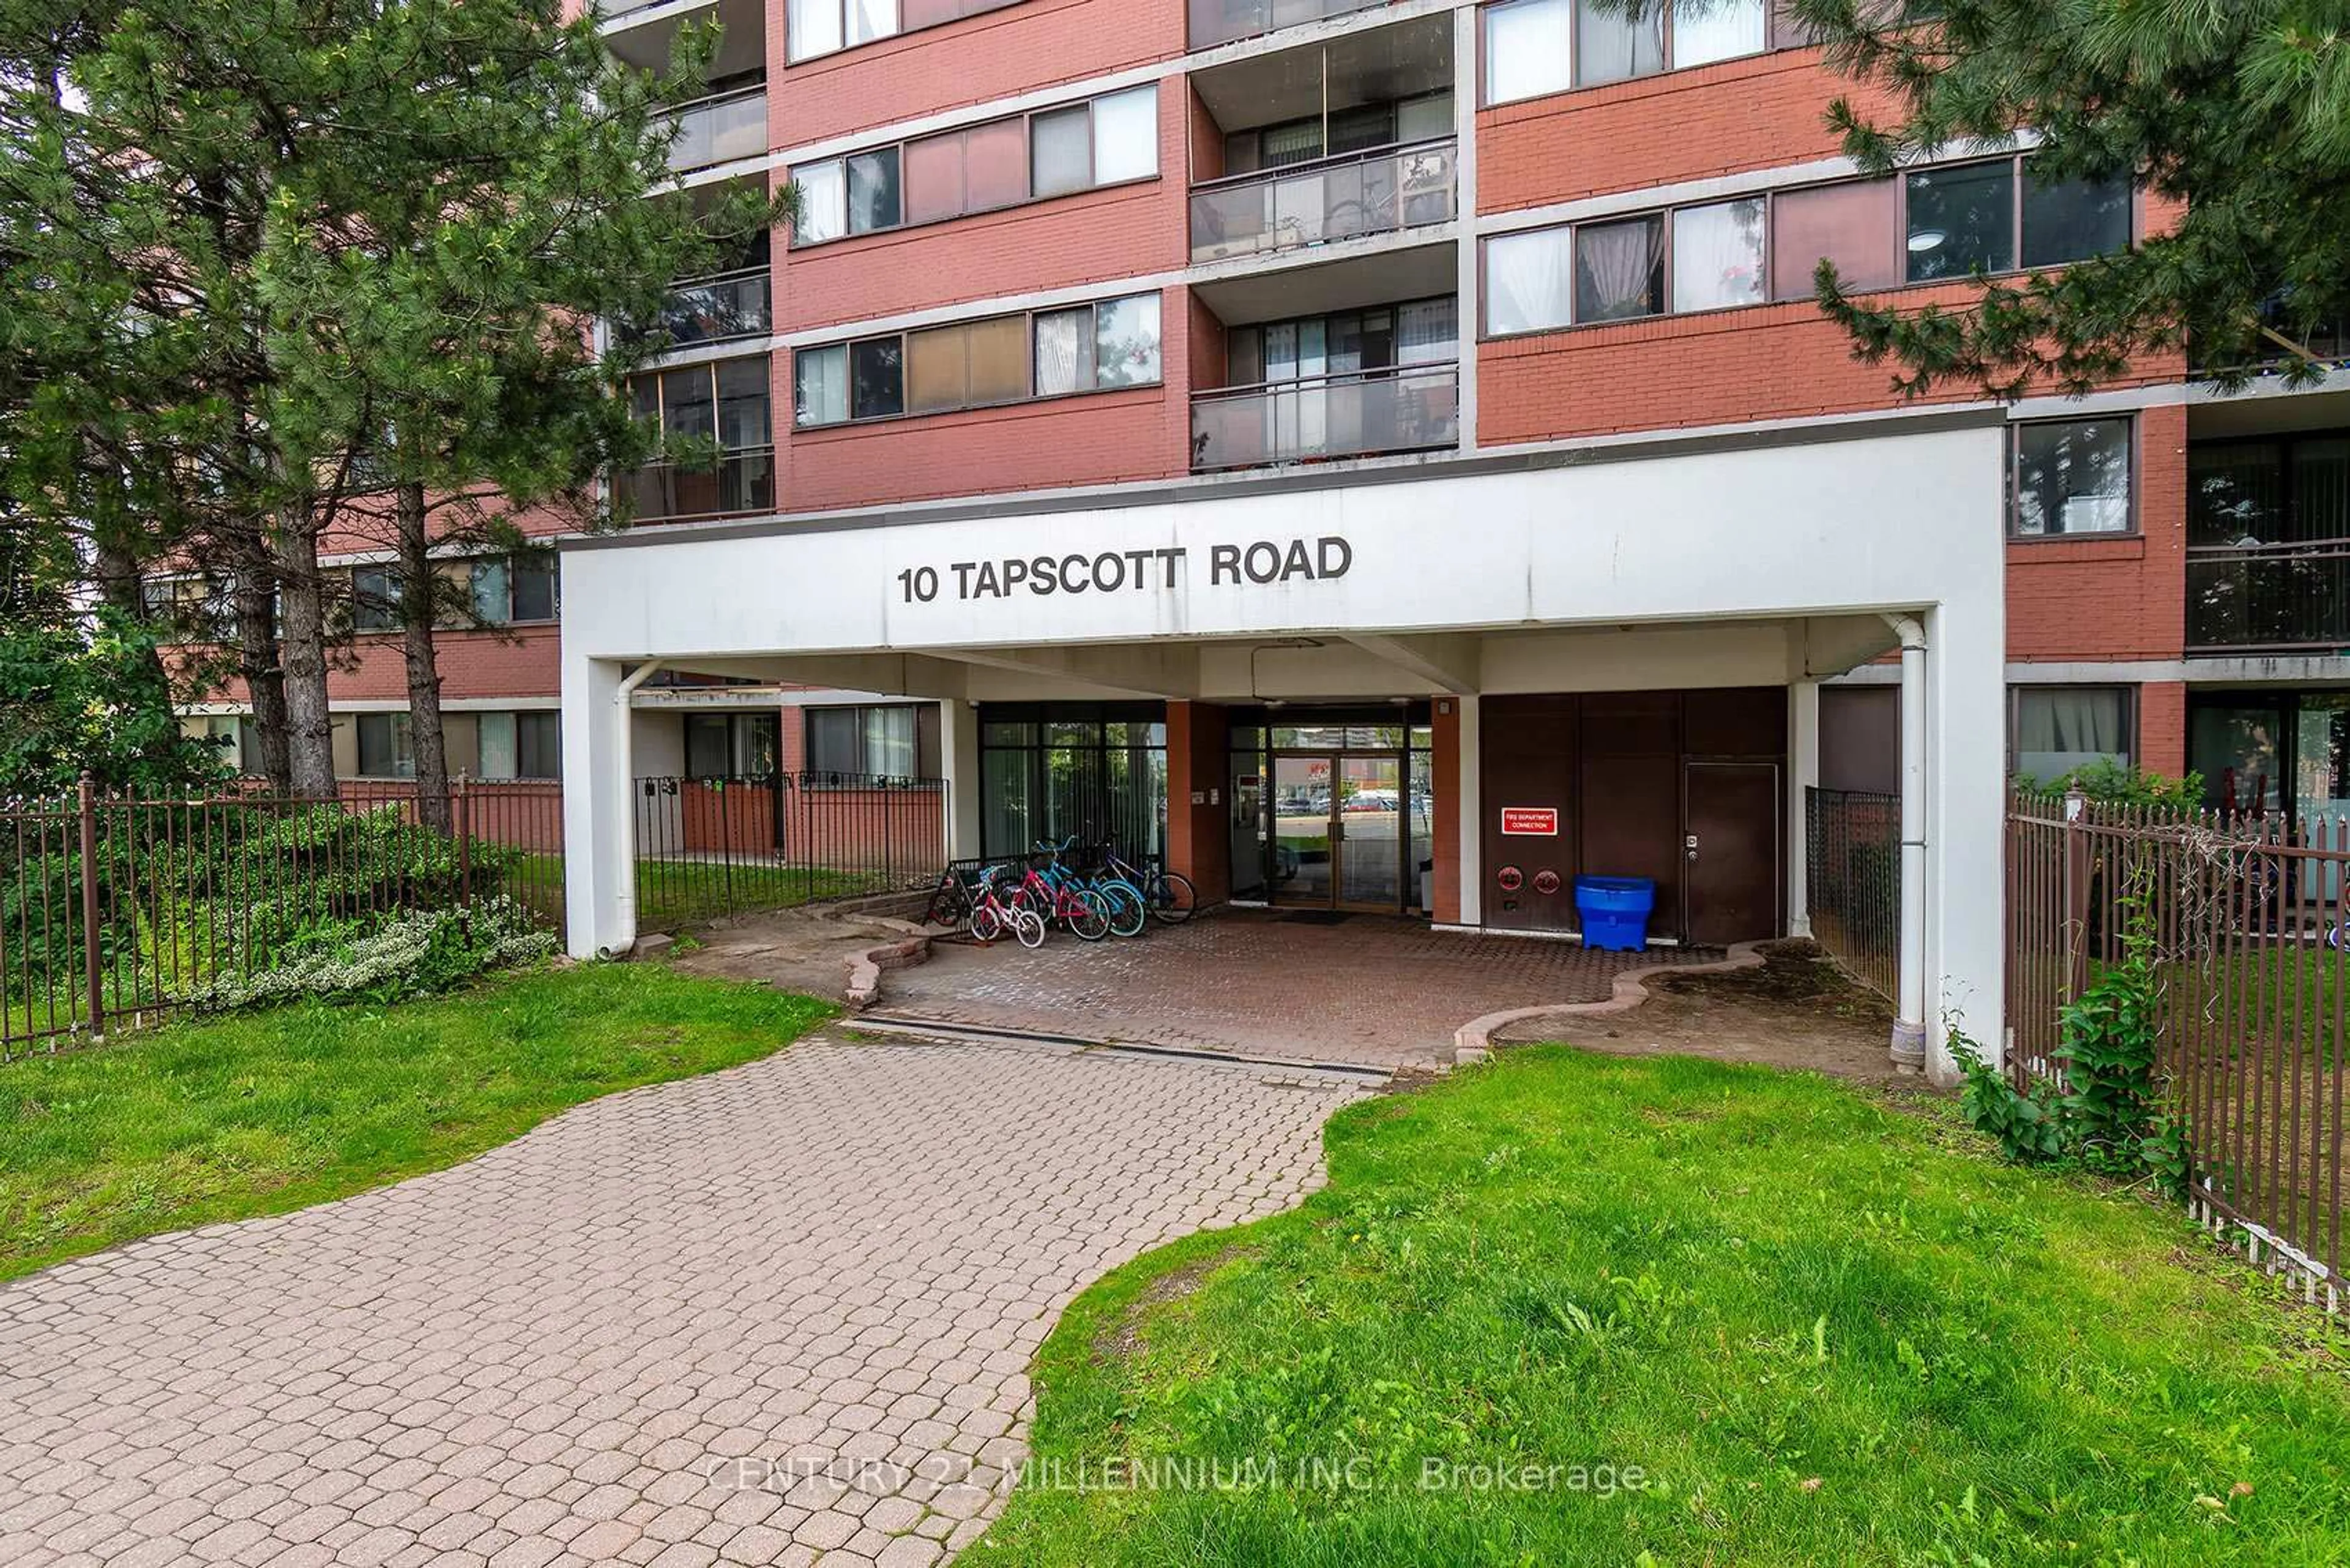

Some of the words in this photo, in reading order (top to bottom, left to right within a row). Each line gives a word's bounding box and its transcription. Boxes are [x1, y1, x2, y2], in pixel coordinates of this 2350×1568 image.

[897, 568, 938, 603] 10
[951, 548, 1187, 599] TAPSCOTT
[1210, 536, 1352, 586] ROAD
